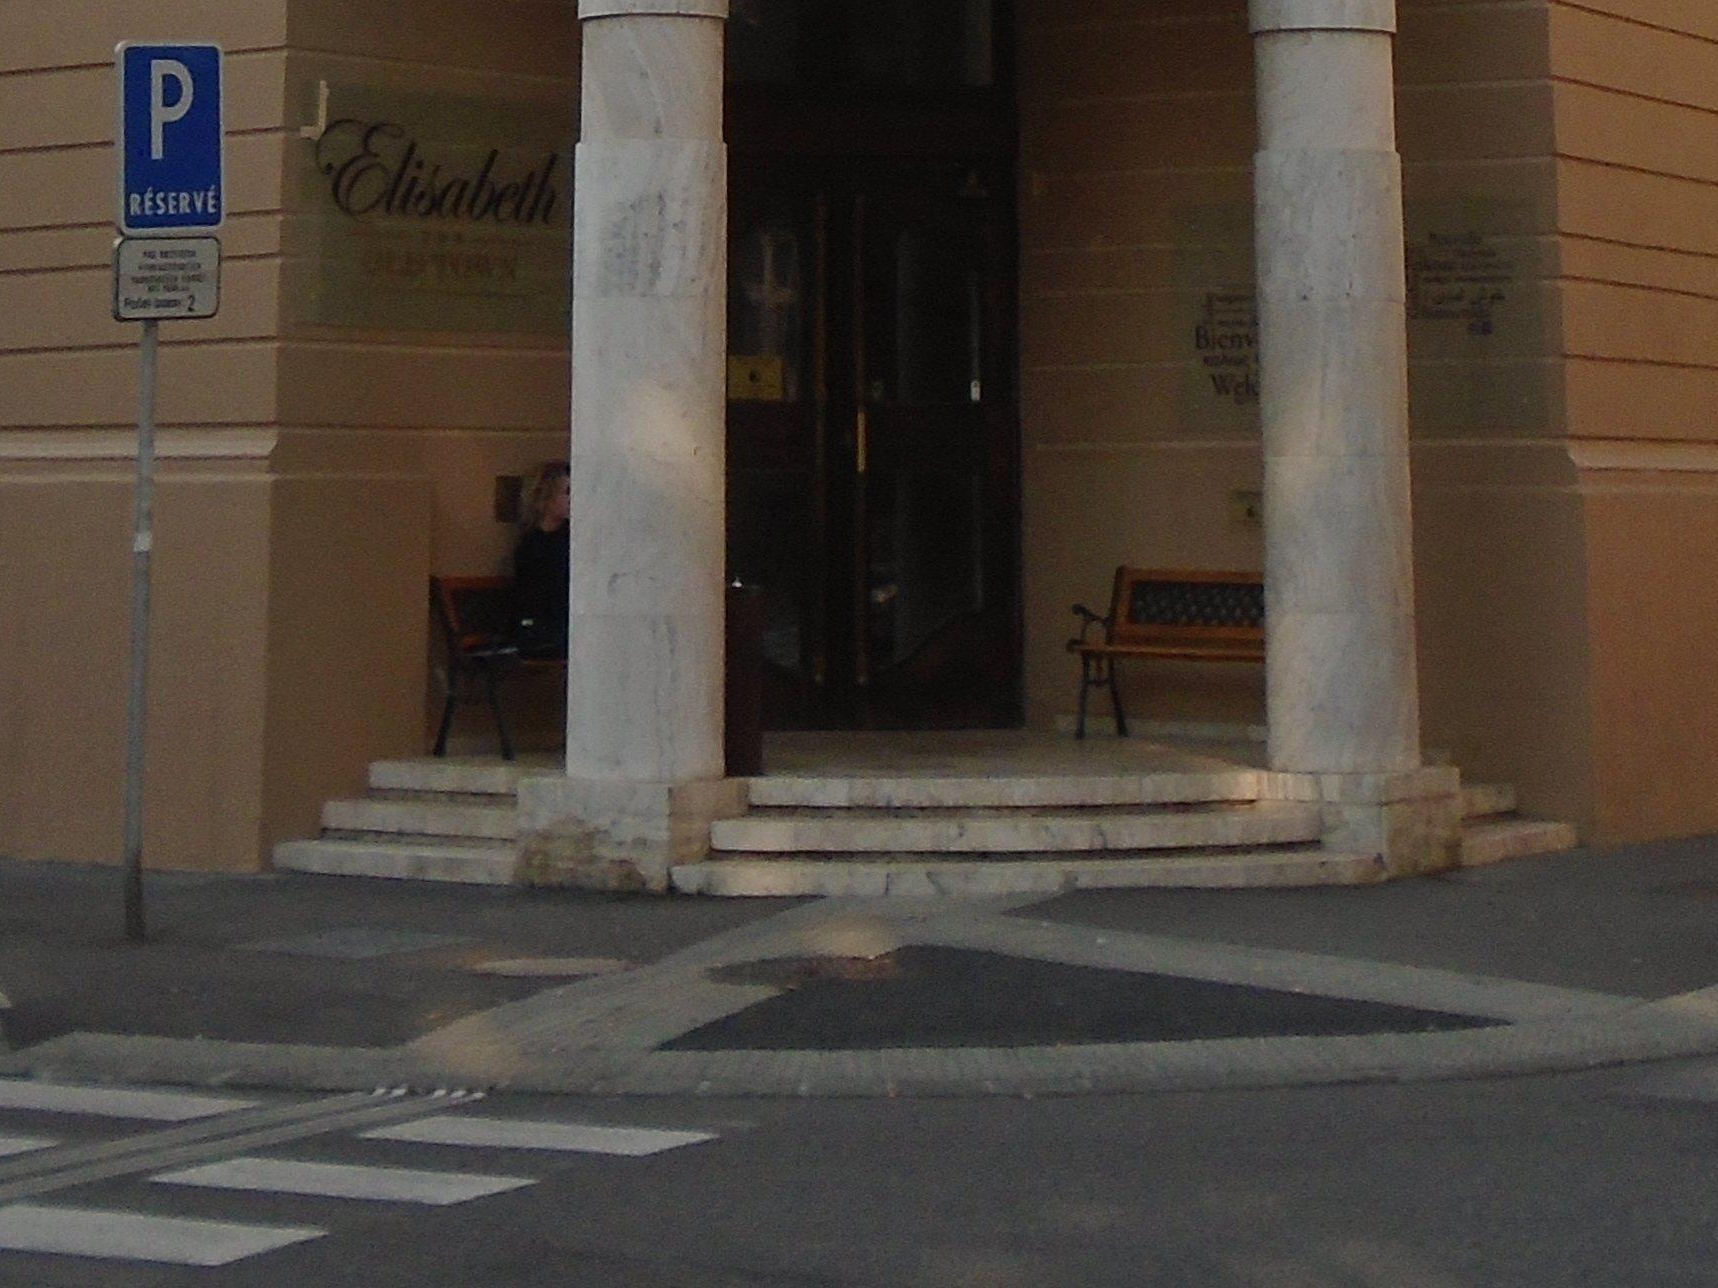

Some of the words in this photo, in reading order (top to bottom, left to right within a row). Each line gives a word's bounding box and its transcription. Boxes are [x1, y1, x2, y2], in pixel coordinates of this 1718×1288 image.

[150, 58, 195, 161] P
[128, 185, 218, 217] RÉSERVÉ
[315, 118, 560, 226] Elisabeth
[1195, 325, 1259, 350] Bienv
